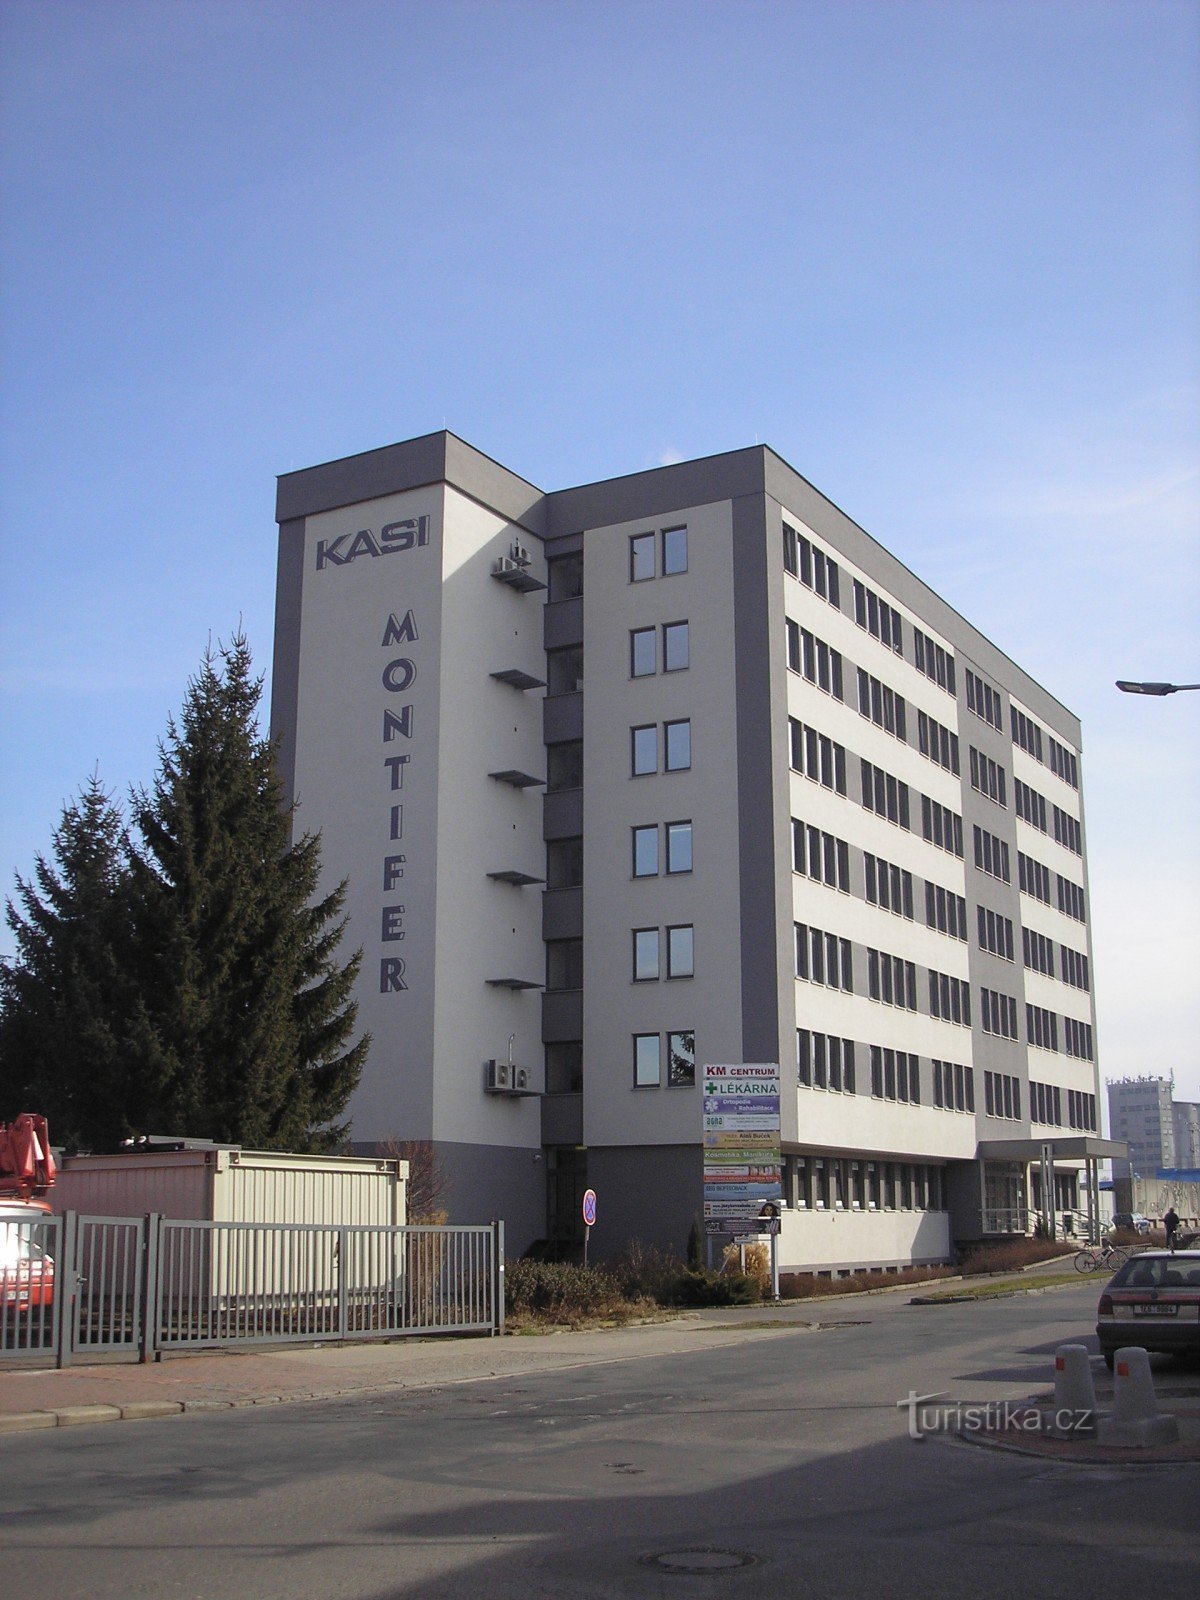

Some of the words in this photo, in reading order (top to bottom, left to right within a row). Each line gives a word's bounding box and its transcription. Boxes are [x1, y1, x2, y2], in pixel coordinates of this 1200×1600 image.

[316, 515, 430, 571] KASI
[380, 609, 419, 994] MONTIFER
[706, 1066, 726, 1076] KM
[730, 1068, 775, 1076] CENTRUM
[720, 1082, 777, 1094] LÉKÁRNA
